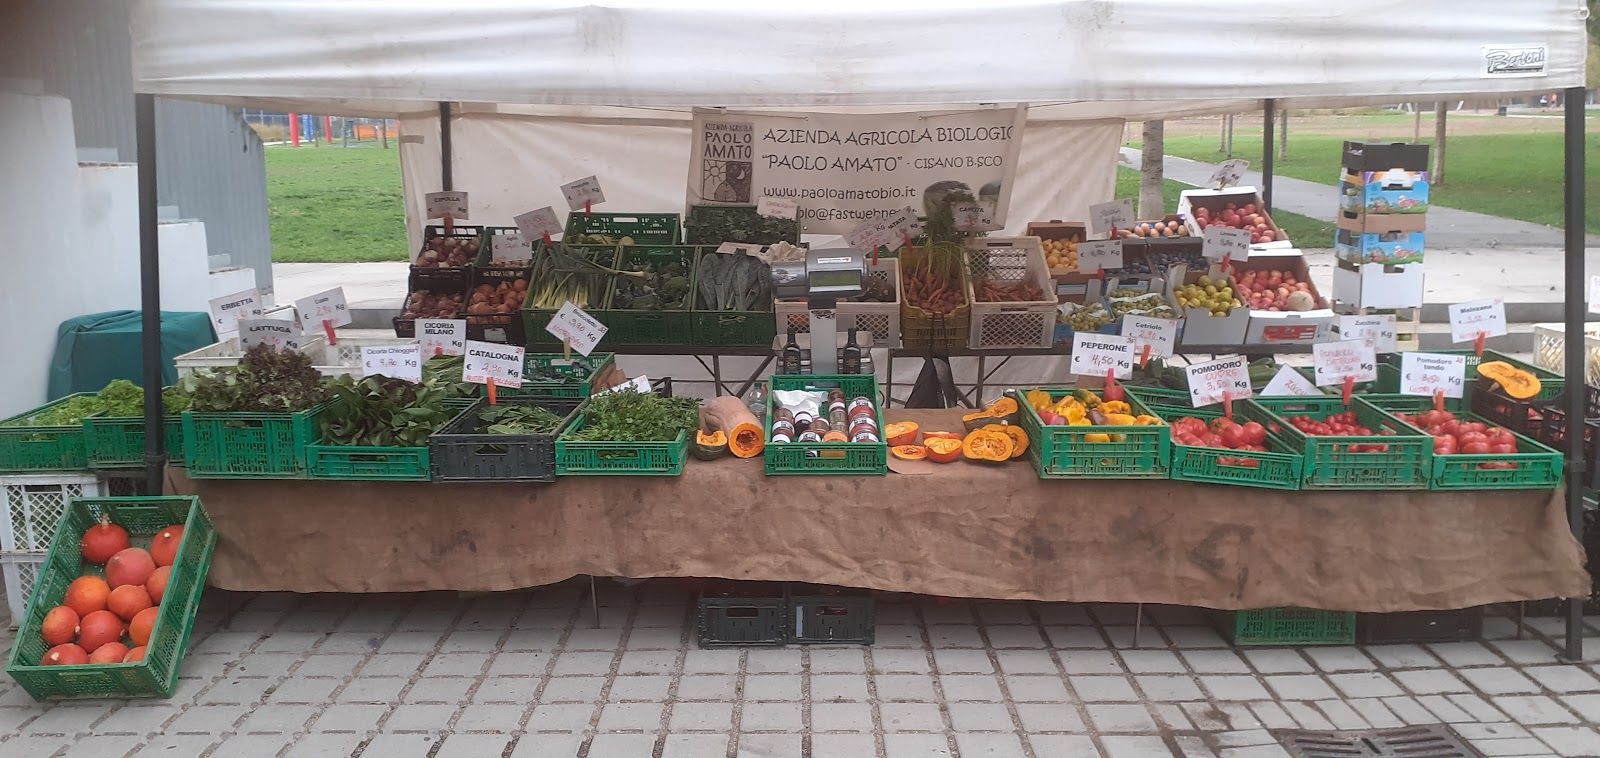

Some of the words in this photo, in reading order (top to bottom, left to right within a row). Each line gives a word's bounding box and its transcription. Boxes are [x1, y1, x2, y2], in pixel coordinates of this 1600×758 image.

[704, 131, 752, 144] PAOLO
[763, 129, 841, 145] AZIENDA
[844, 127, 933, 146] AGRICOLA
[704, 143, 752, 159] AMATO
[914, 156, 964, 170] CISANO
[763, 185, 916, 200] www.paoloamatobio.it
[220, 297, 254, 311] ERBETTA
[335, 303, 345, 311] Kg
[252, 308, 262, 316] Kg
[249, 325, 292, 334] LATTUGA
[1135, 322, 1163, 331] Cetriolo
[587, 331, 597, 343] Kg
[1380, 330, 1393, 339] Kg
[286, 340, 298, 349] Kg
[451, 340, 463, 348] Kg
[1080, 341, 1128, 353] PEPERONE
[469, 349, 520, 362] CATALOGNA
[365, 360, 372, 368] €
[405, 359, 418, 368] Kg
[1074, 355, 1081, 363] €
[1091, 353, 1114, 367] 4,50
[1117, 360, 1130, 369] Kg
[1416, 357, 1453, 365] Pomodoro
[466, 363, 473, 371] €
[507, 368, 519, 378] Kg
[1191, 360, 1242, 375] POMODORO
[1360, 362, 1373, 371] Kg
[1234, 381, 1248, 389] Kg
[1448, 376, 1461, 385] Kg
[1193, 388, 1200, 396] €
